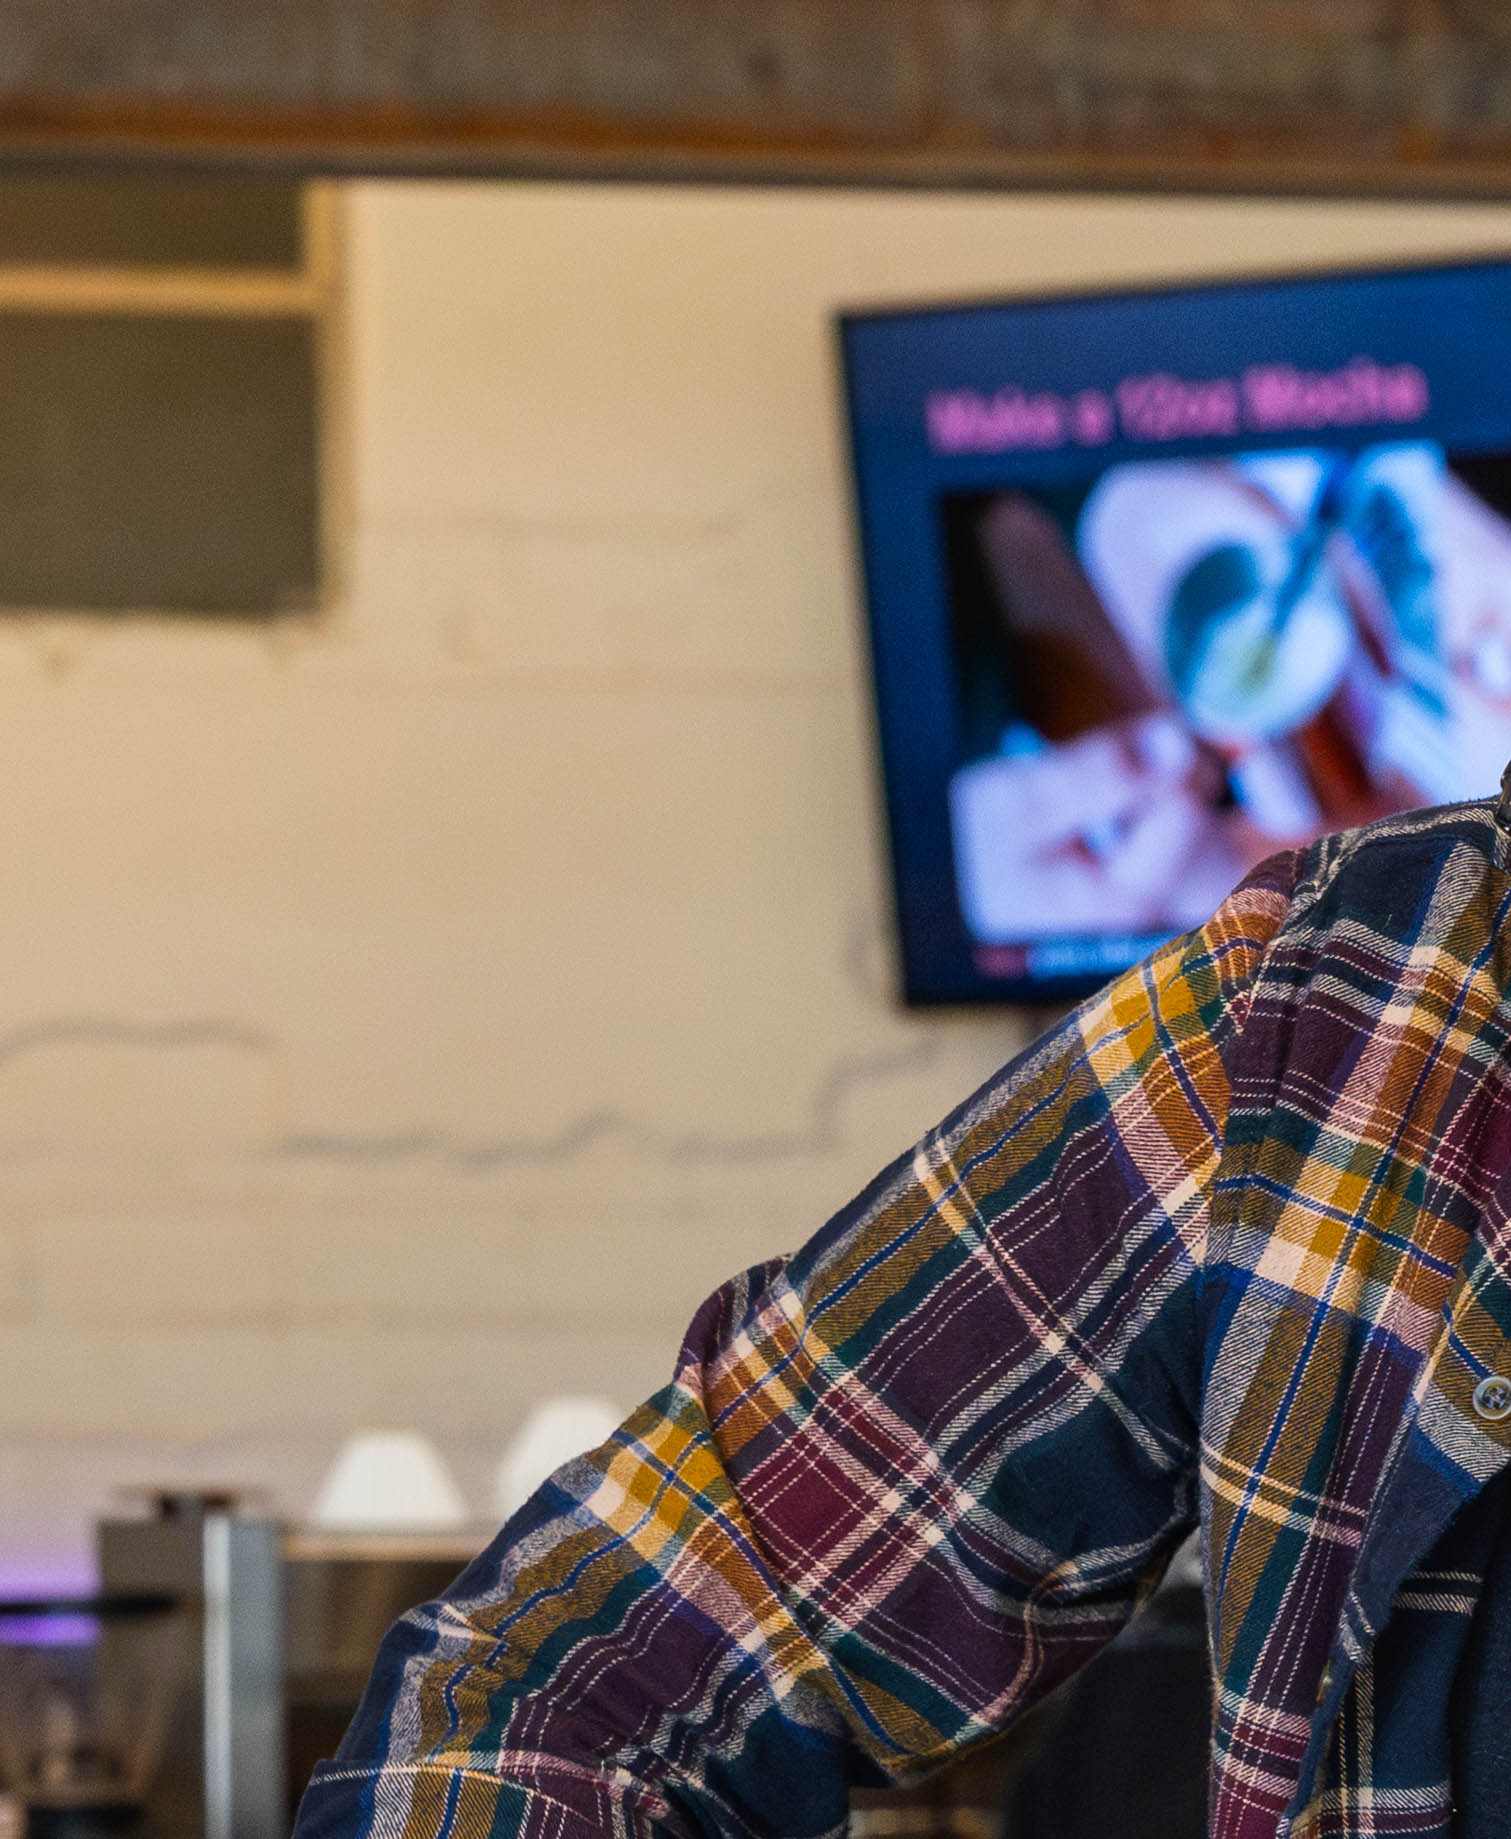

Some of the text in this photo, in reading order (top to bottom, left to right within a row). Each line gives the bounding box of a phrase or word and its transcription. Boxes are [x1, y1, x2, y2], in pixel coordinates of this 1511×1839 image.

[928, 386, 1064, 456] Make
[1074, 388, 1115, 447] a
[1243, 354, 1429, 432] Mocha
